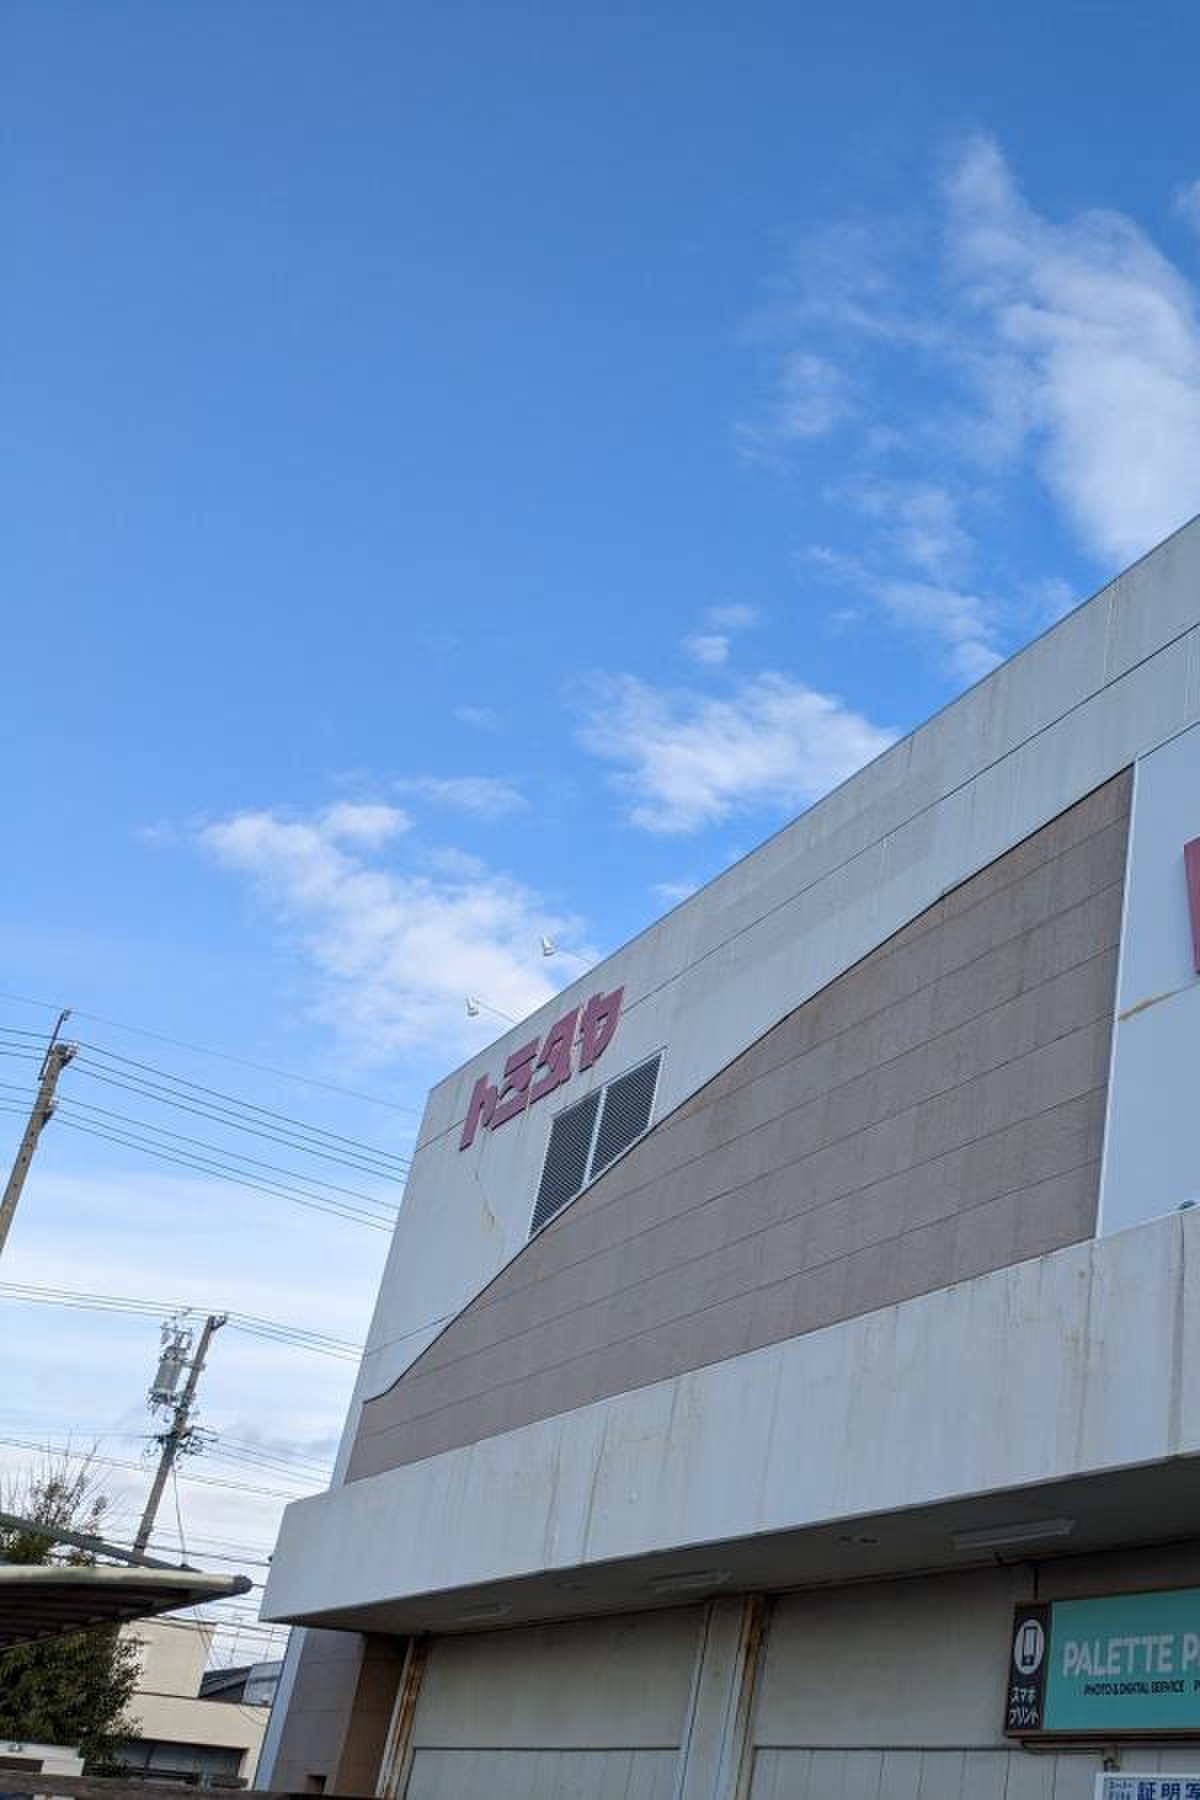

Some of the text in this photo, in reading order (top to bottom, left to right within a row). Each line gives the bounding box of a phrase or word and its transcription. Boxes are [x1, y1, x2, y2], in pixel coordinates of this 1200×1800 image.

[459, 986, 625, 1152] トミタヤ
[1062, 1634, 1174, 1677] PALETTE
